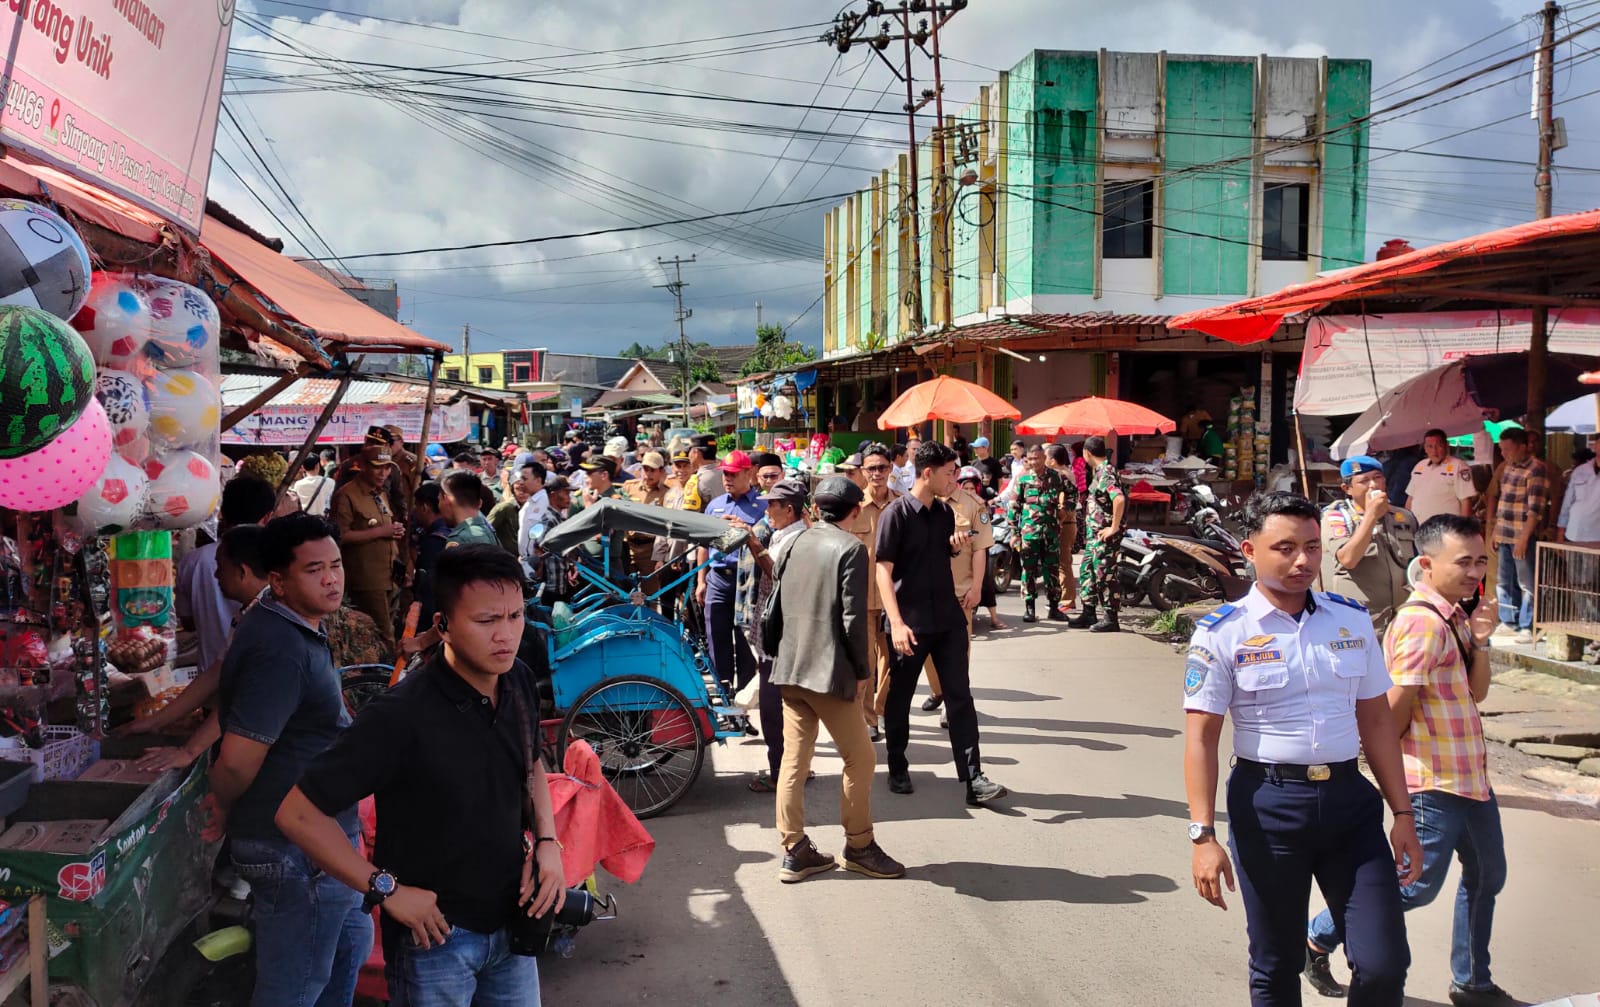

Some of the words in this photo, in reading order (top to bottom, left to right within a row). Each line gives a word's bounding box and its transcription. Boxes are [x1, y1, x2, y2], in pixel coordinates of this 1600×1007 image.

[0, 0, 75, 64] rang
[77, 15, 113, 80] Unik
[6, 80, 45, 129] 4466
[62, 113, 109, 173] Simpang
[110, 141, 118, 170] 4
[116, 145, 143, 183] Pasar
[142, 161, 162, 200] Pagi
[262, 416, 308, 425] MANG
[116, 824, 147, 856] Santan
